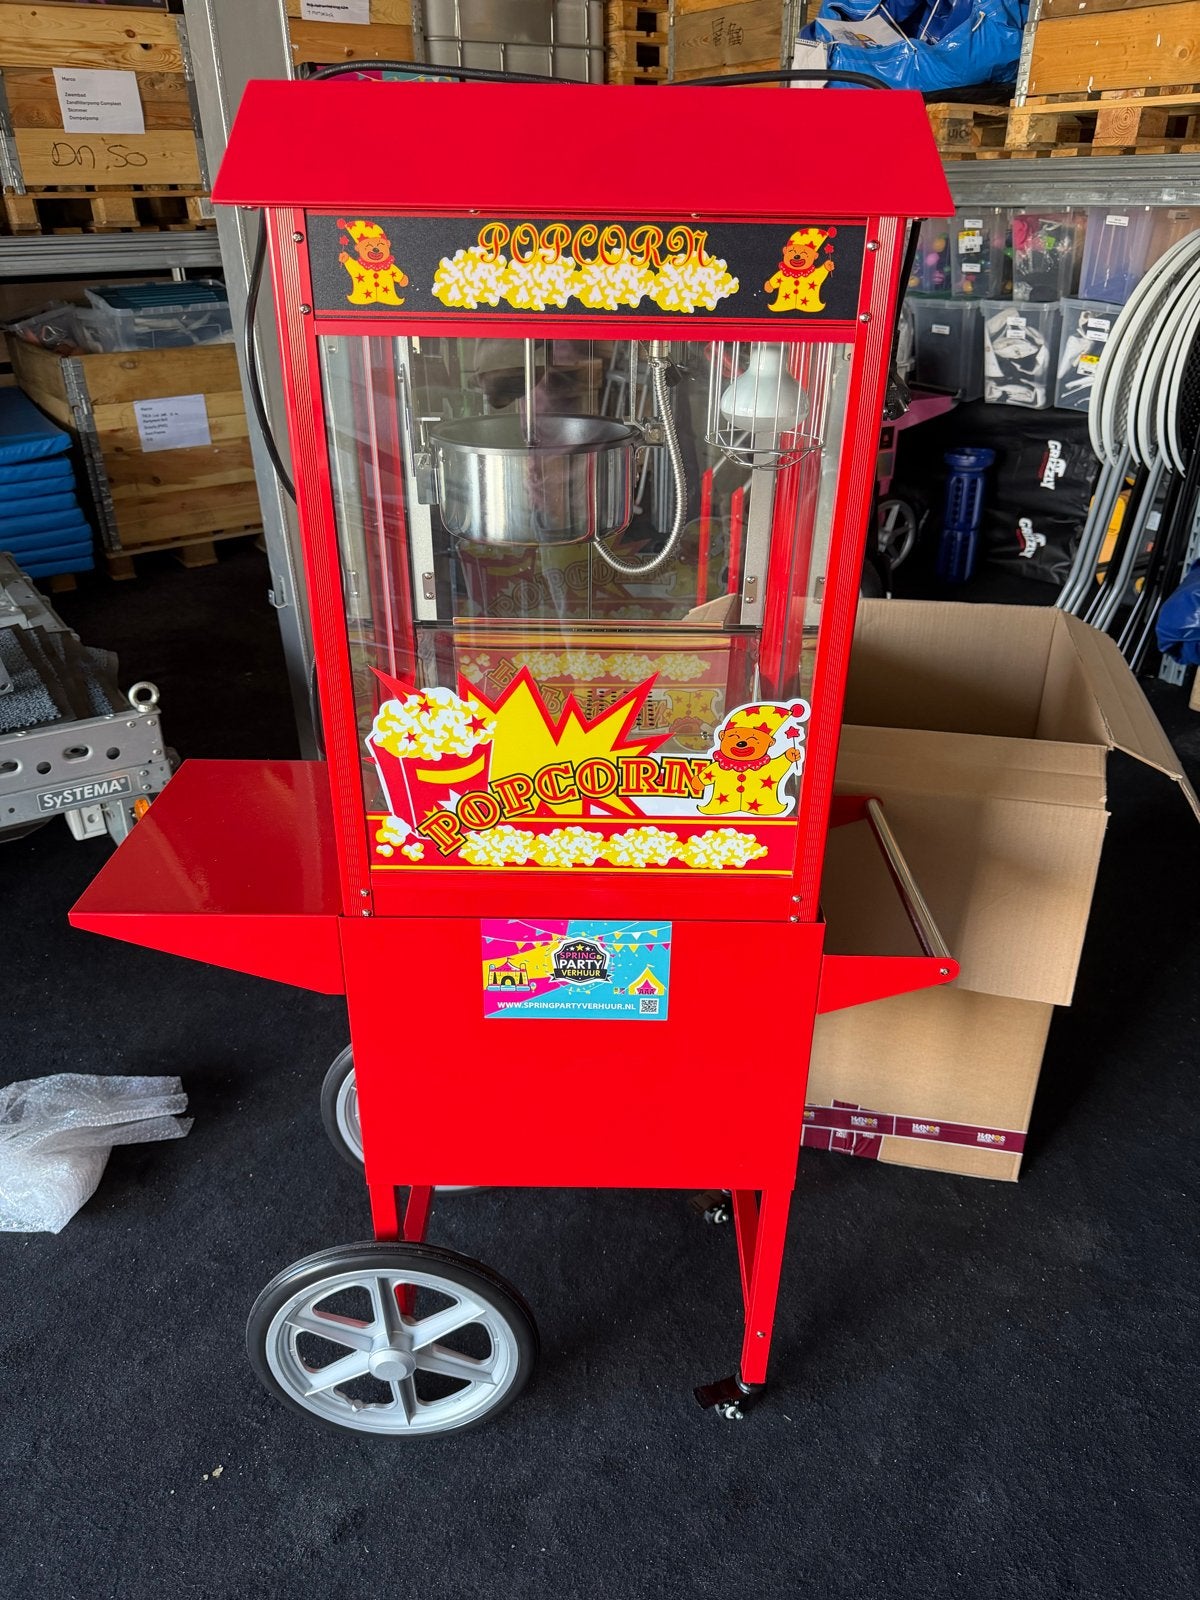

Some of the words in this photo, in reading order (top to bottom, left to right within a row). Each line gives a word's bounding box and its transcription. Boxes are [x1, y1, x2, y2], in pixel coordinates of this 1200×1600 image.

[478, 222, 716, 267] POPCORN
[415, 756, 713, 857] POPCORN
[559, 959, 603, 970] PARTY
[561, 969, 601, 977] VERHUUR
[497, 1001, 636, 1011] WWW.SPRINGPARTYVERHUUR.NL
